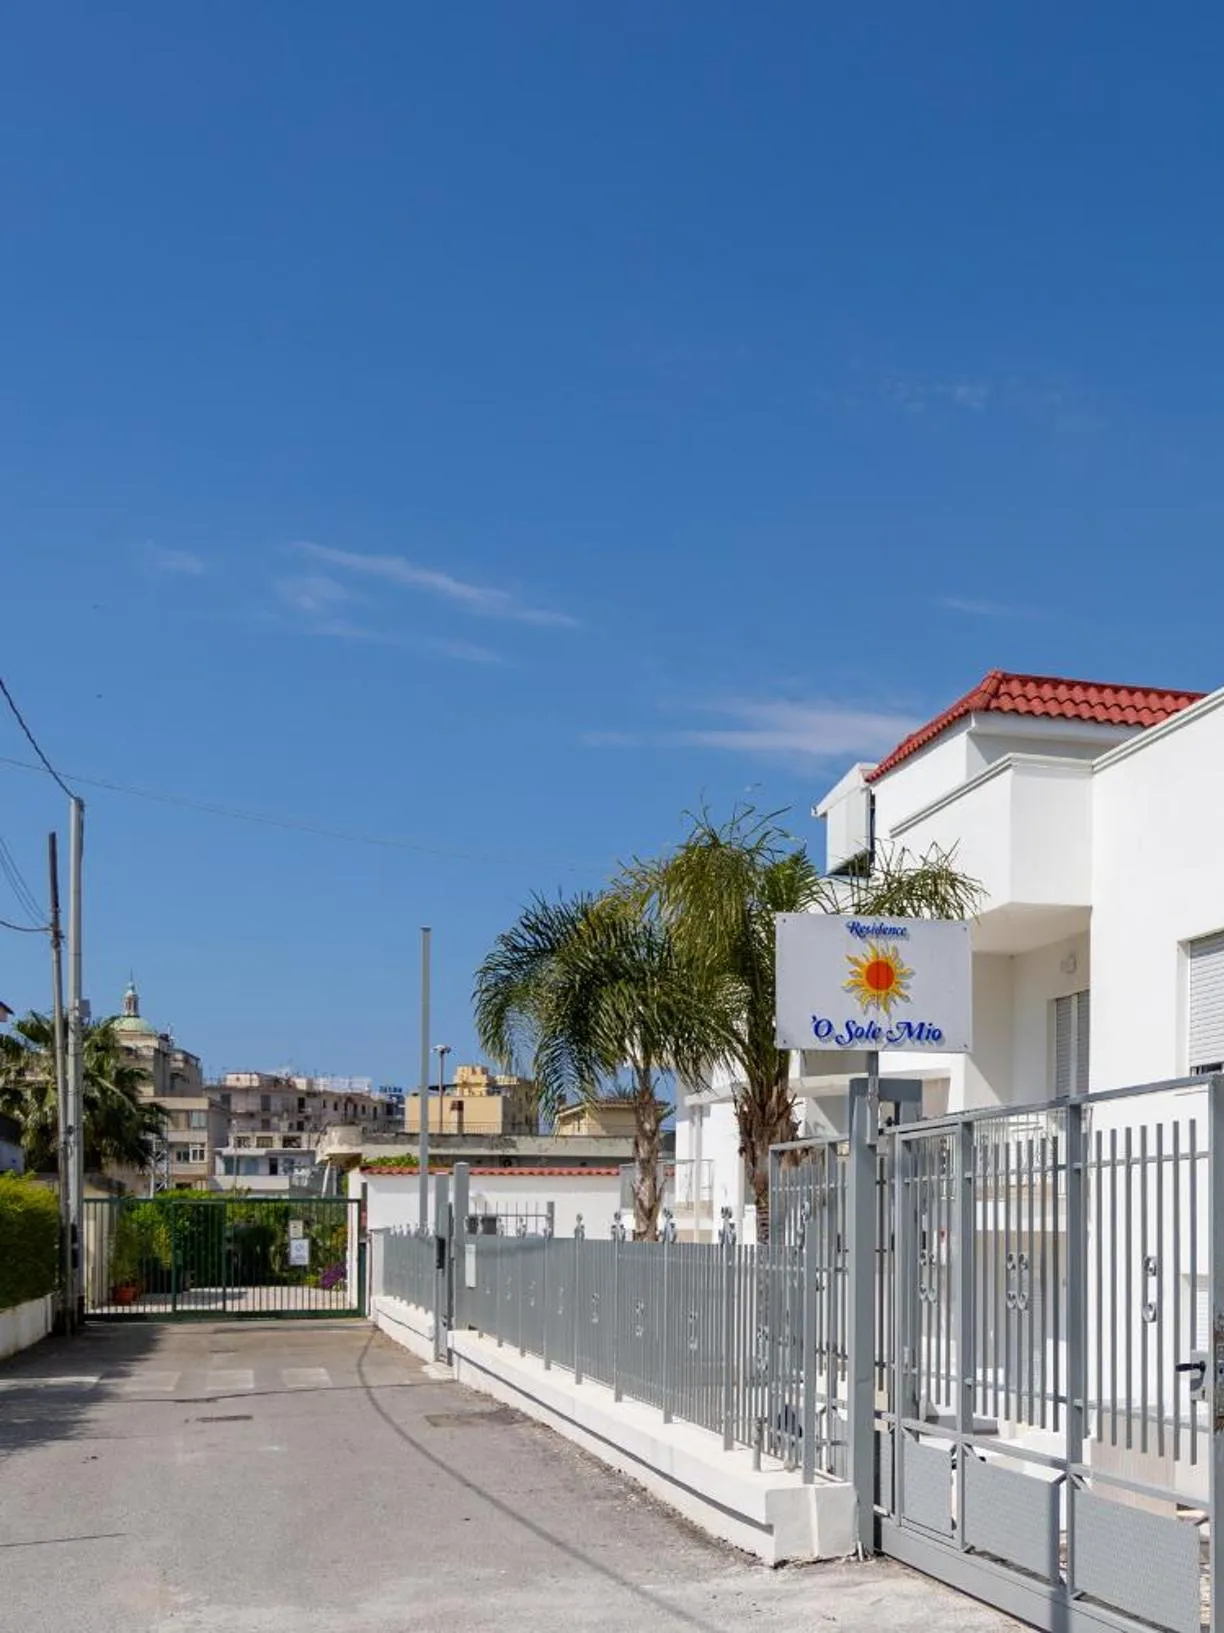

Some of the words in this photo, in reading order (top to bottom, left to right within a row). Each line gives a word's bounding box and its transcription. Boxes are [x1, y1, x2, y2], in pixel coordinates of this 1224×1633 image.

[846, 920, 908, 939] Residence
[835, 1019, 882, 1045] Sole
[886, 1021, 943, 1042] Mio
